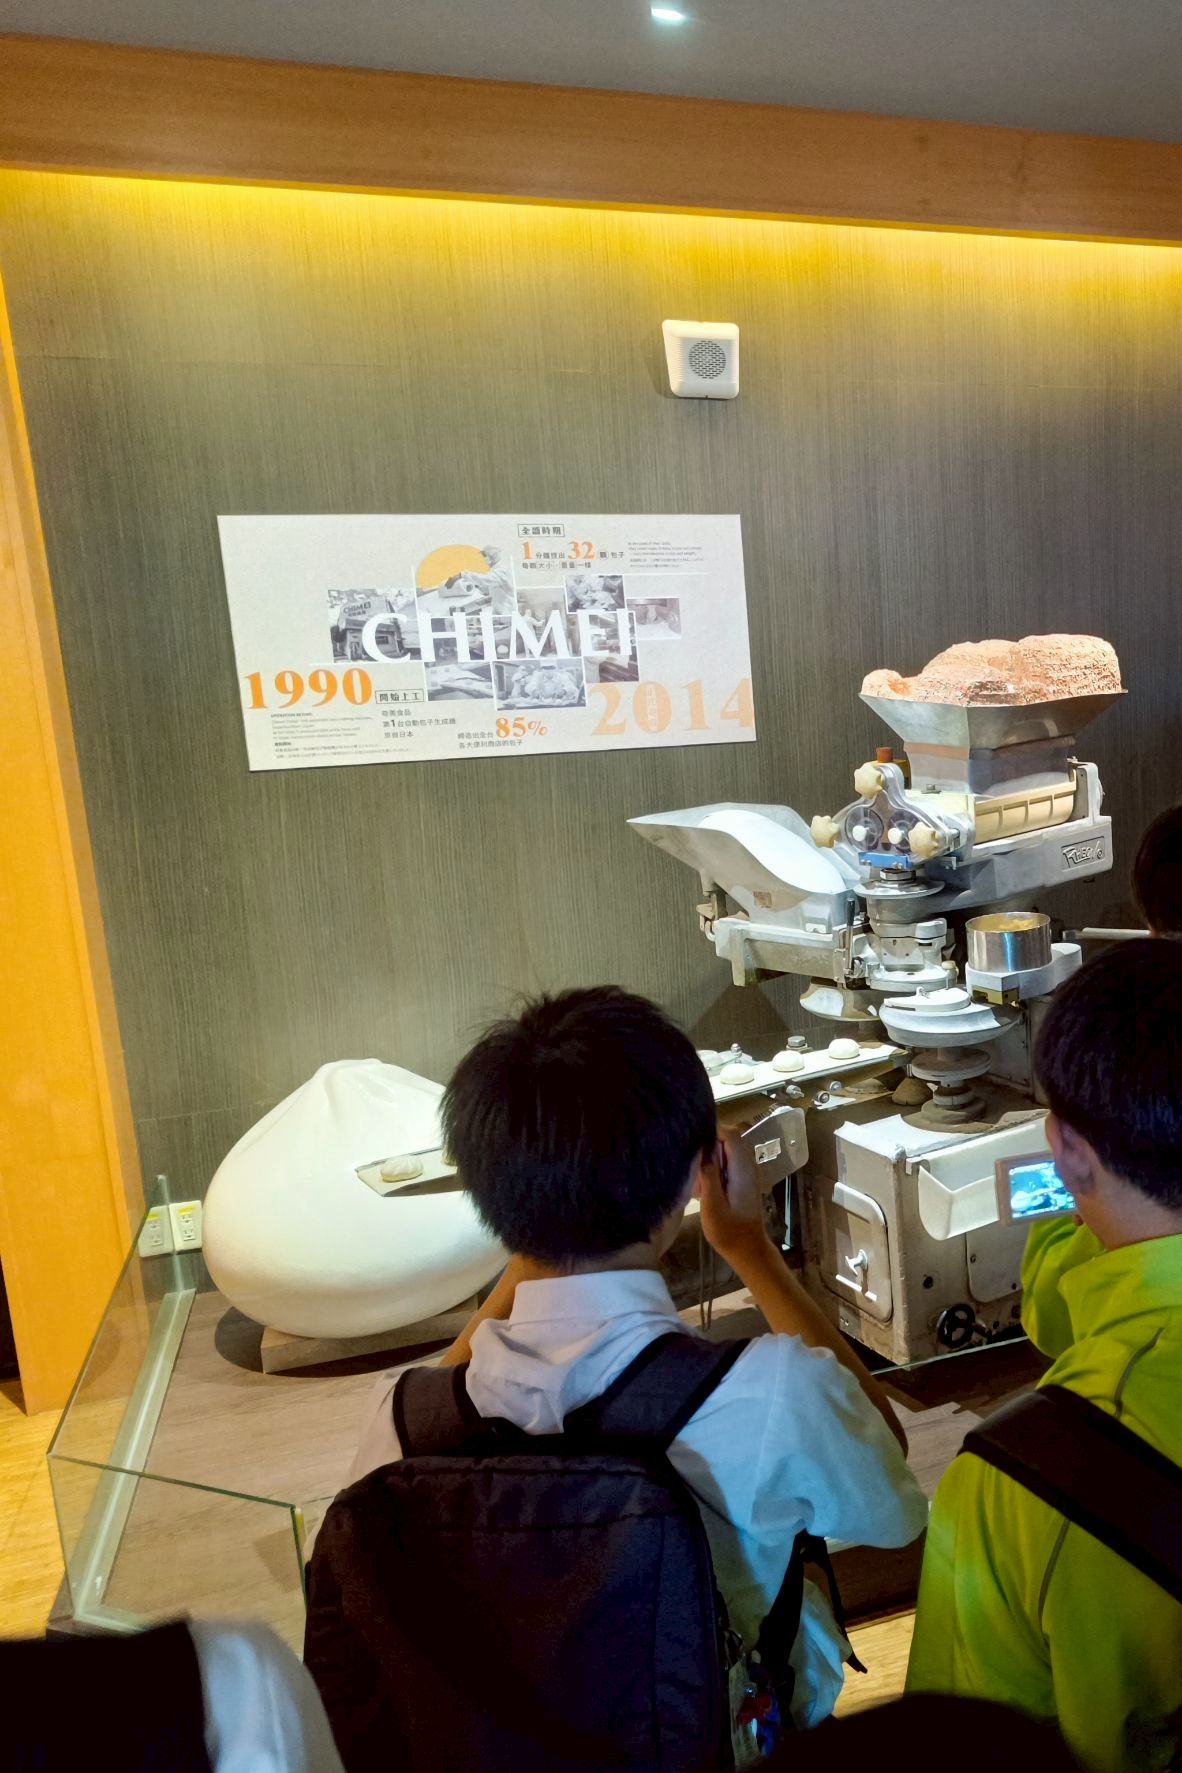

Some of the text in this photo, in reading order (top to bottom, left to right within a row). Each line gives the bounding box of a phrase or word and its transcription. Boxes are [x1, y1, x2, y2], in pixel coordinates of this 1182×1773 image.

[523, 541, 532, 560] 1
[568, 541, 595, 560] 32
[361, 608, 633, 662] CHIMEI
[243, 667, 373, 710] 1990
[379, 692, 420, 701] 開始上工
[588, 677, 755, 736] 2014
[495, 717, 548, 739] 85%
